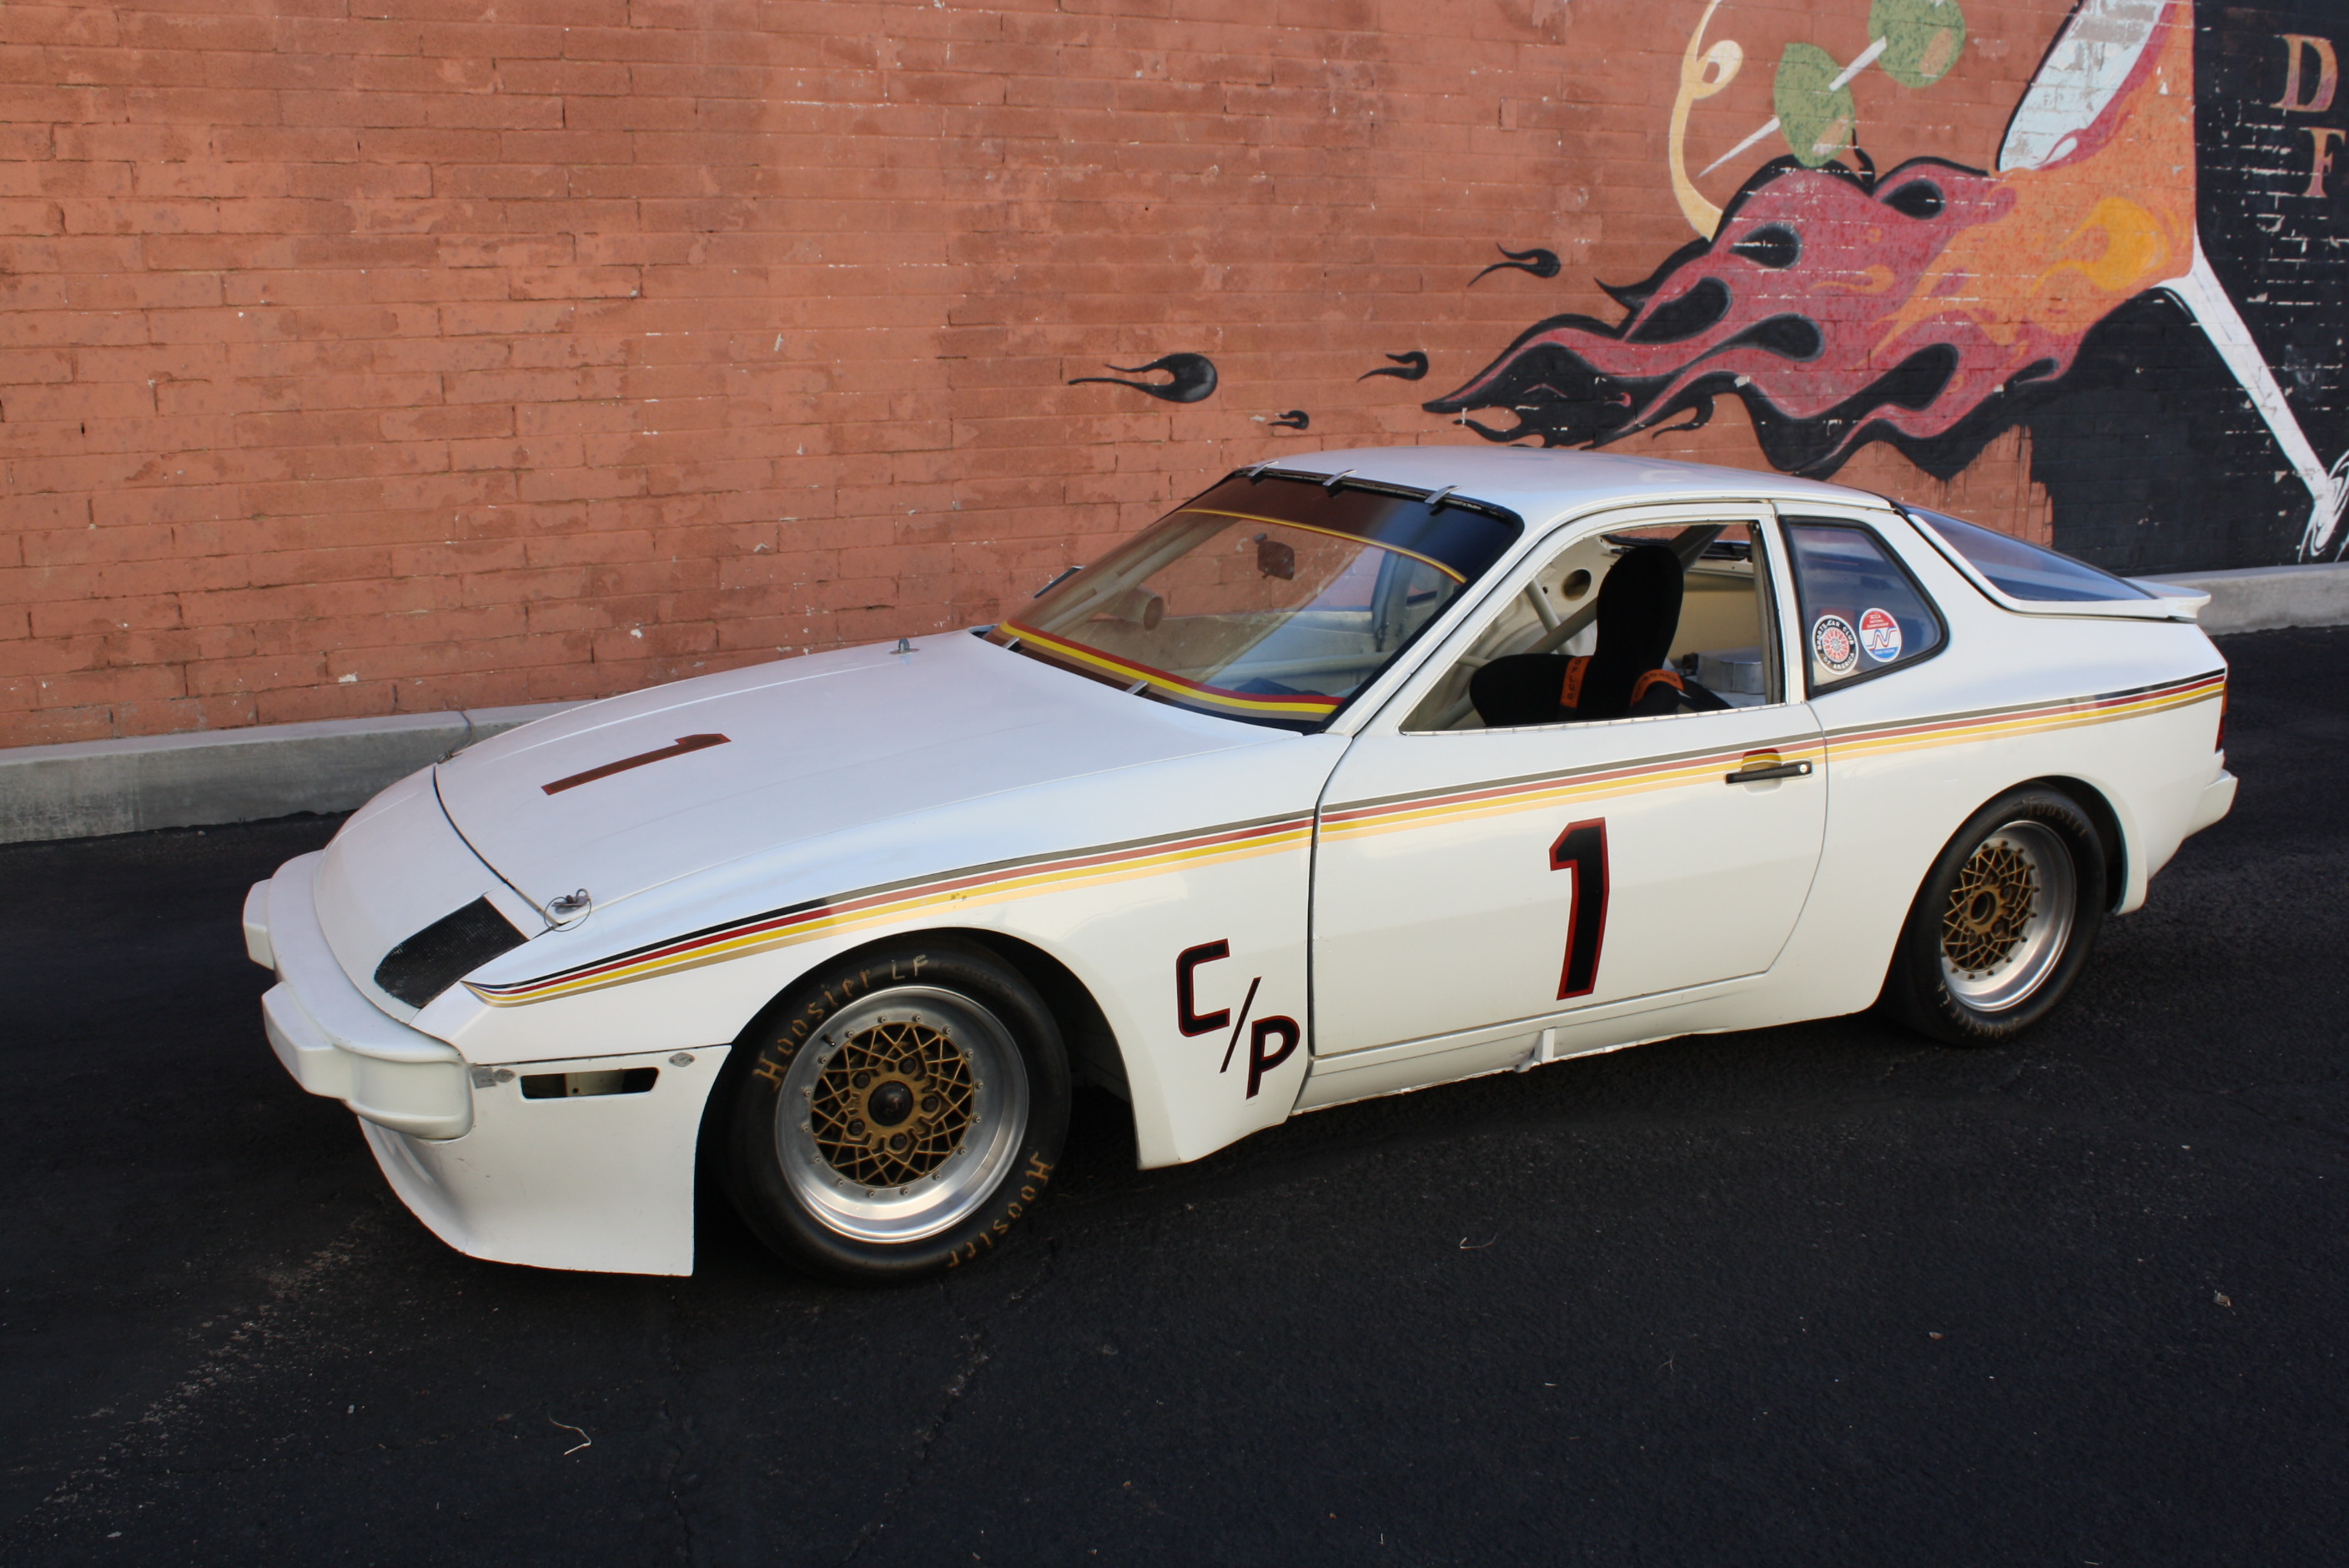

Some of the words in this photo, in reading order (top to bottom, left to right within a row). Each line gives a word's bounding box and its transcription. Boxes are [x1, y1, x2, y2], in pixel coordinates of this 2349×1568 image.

[1823, 656, 1832, 665] OF
[1833, 652, 1854, 669] AMERICA
[1827, 620, 1840, 628] CAR
[1842, 626, 1854, 646] CLUB
[541, 733, 732, 796] 1
[1549, 817, 1610, 1001] 1
[752, 968, 872, 1091] Hoosier
[1176, 937, 1300, 1100] C/P
[948, 1151, 1054, 1268] Hoosier
